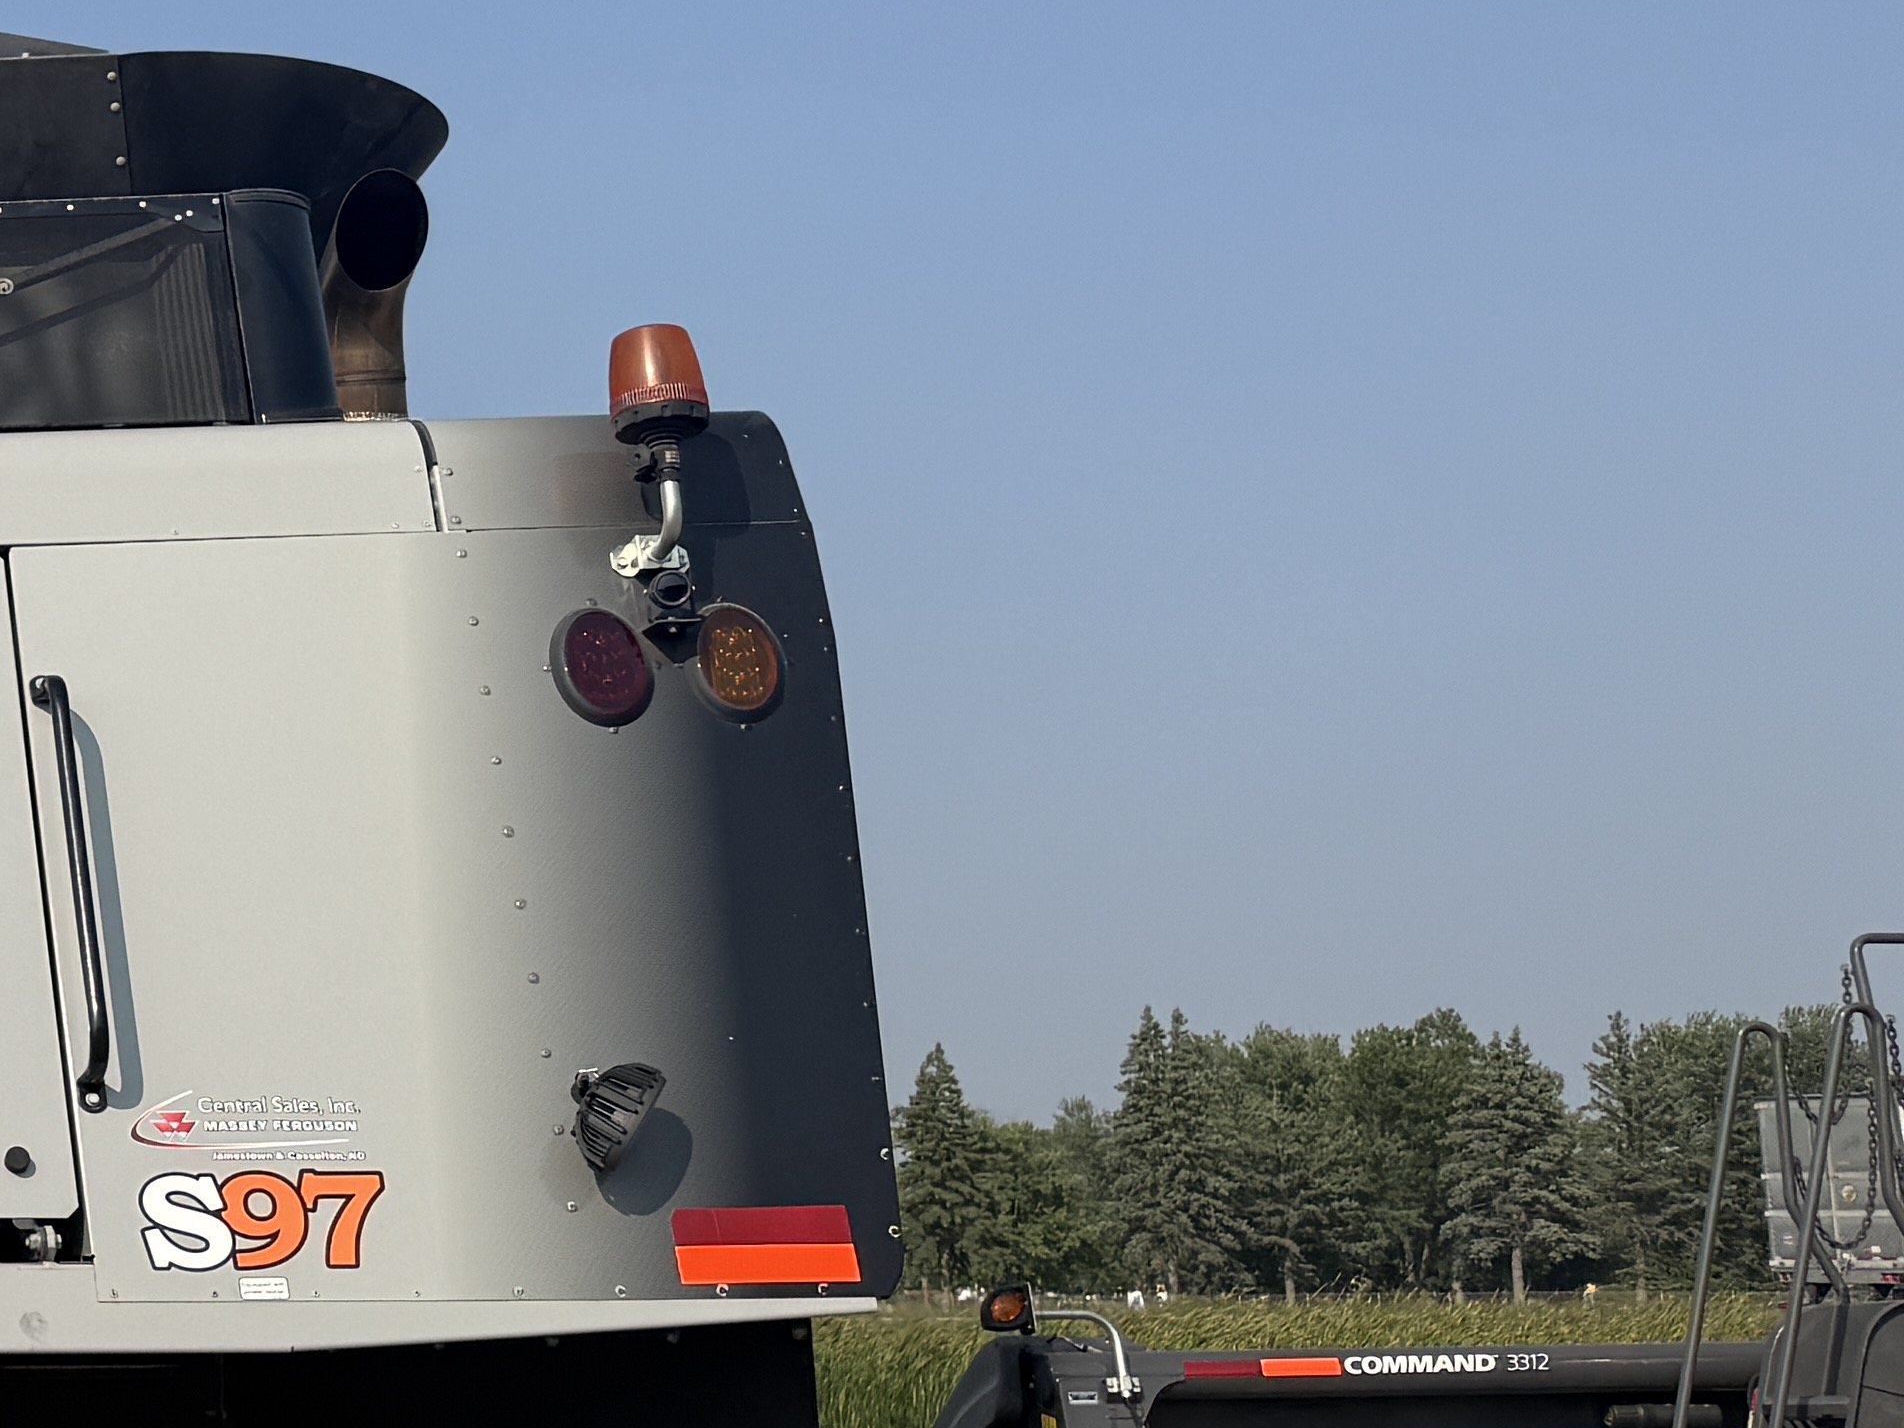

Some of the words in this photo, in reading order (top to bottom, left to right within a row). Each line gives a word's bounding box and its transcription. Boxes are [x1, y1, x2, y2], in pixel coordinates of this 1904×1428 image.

[197, 1096, 267, 1114] Central
[271, 1096, 324, 1115] Sales,
[328, 1097, 362, 1114] Inc.
[203, 1120, 268, 1132] MASSEY
[273, 1120, 358, 1132] FERGUSON
[138, 1169, 385, 1272] S97
[1344, 1354, 1498, 1375] COMMAND
[1506, 1353, 1550, 1371] 3312
